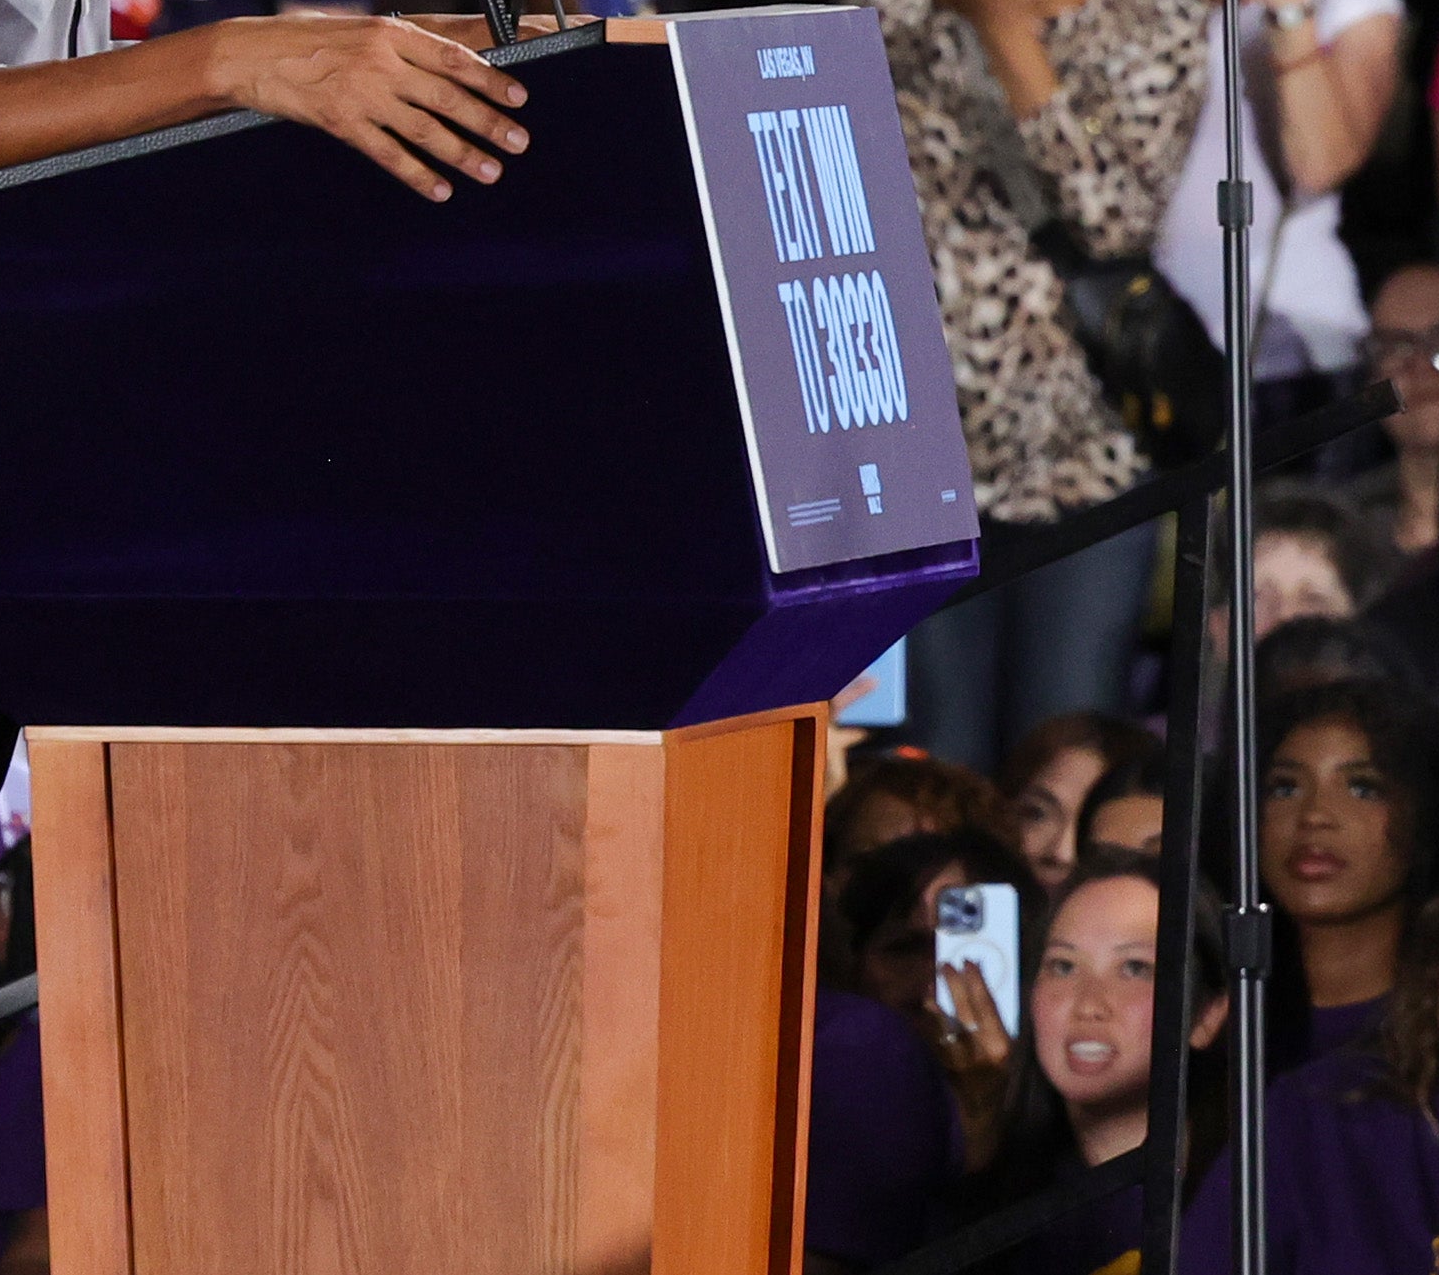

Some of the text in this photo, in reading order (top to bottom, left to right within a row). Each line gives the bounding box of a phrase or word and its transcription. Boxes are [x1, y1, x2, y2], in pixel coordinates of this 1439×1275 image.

[747, 105, 876, 263] TEXT WIN
[778, 269, 908, 434] TO 30330
